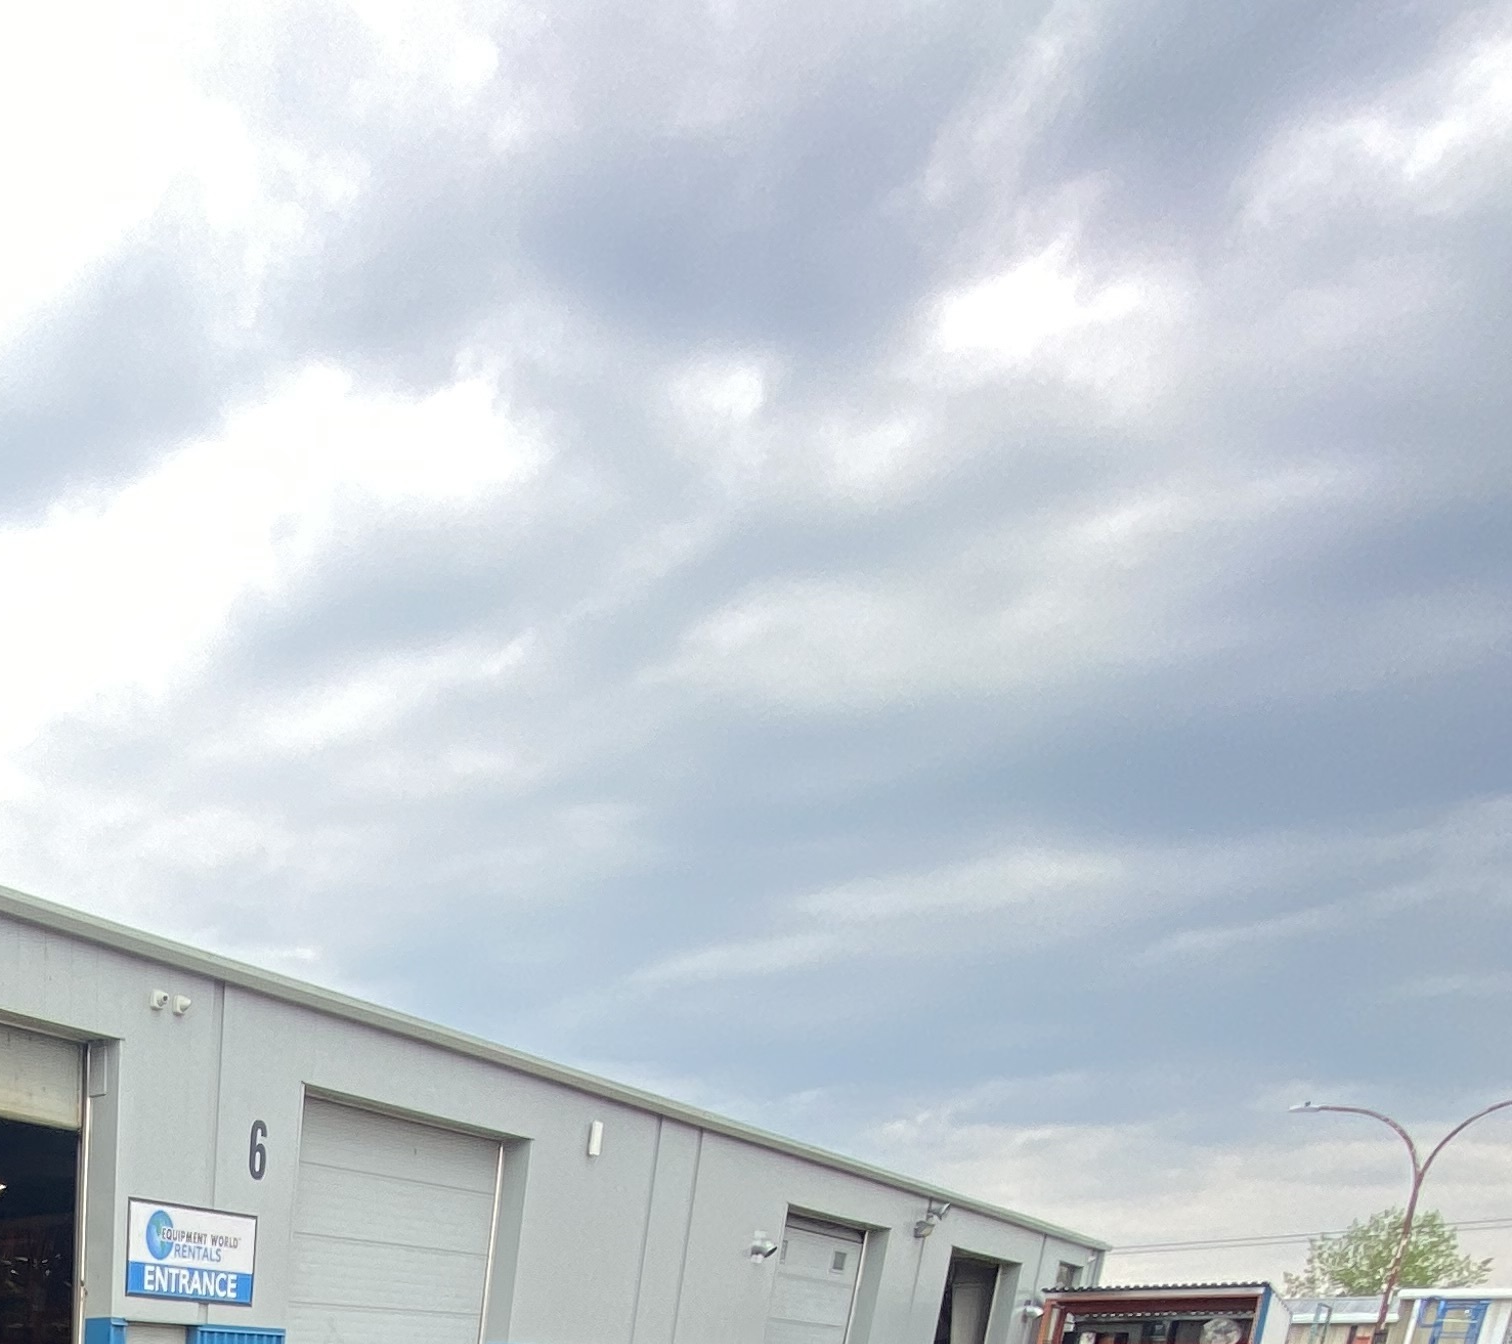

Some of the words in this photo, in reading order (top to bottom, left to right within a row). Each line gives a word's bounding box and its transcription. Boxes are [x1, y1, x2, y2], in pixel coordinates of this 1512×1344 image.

[248, 1119, 268, 1181] 6
[161, 1227, 208, 1246] EQUIPMENT
[211, 1234, 239, 1249] WORLD
[173, 1243, 222, 1263] RENTALS
[143, 1265, 238, 1299] ENTRANCE
